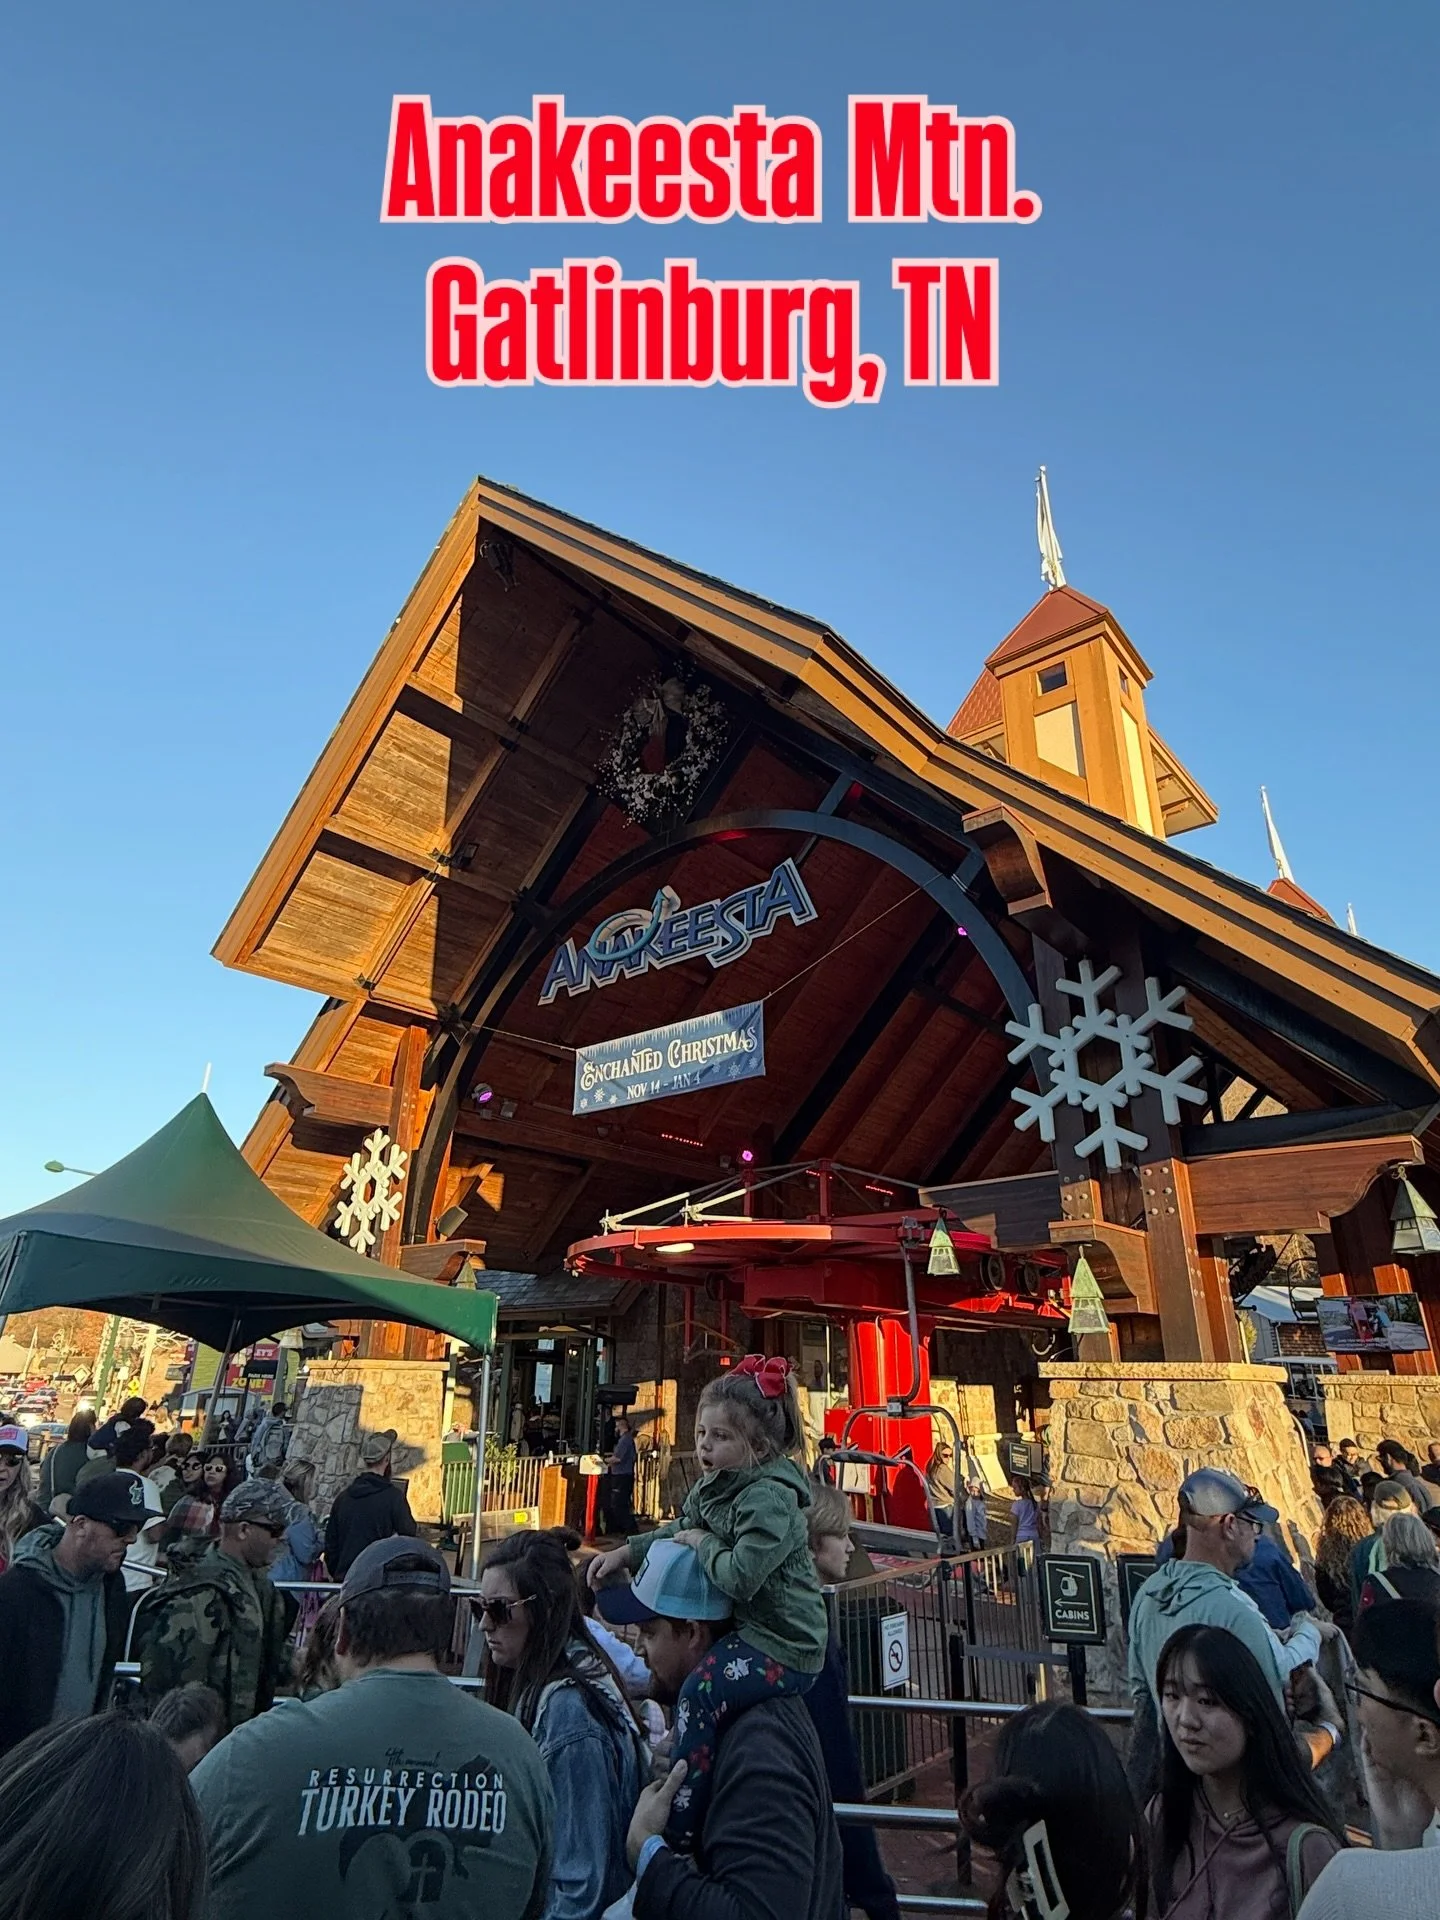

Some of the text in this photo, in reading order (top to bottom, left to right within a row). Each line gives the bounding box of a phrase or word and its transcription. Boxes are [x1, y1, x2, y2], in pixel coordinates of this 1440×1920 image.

[538, 857, 818, 1005] ANAKEESTA
[626, 1081, 648, 1100] NOV
[651, 1080, 661, 1095] 14
[671, 1072, 691, 1090] JAN
[691, 1071, 701, 1085] 4
[1055, 1609, 1090, 1620] CABINS
[309, 1767, 503, 1790] RESURRECTION
[298, 1785, 507, 1836] TURKEY RODEO
